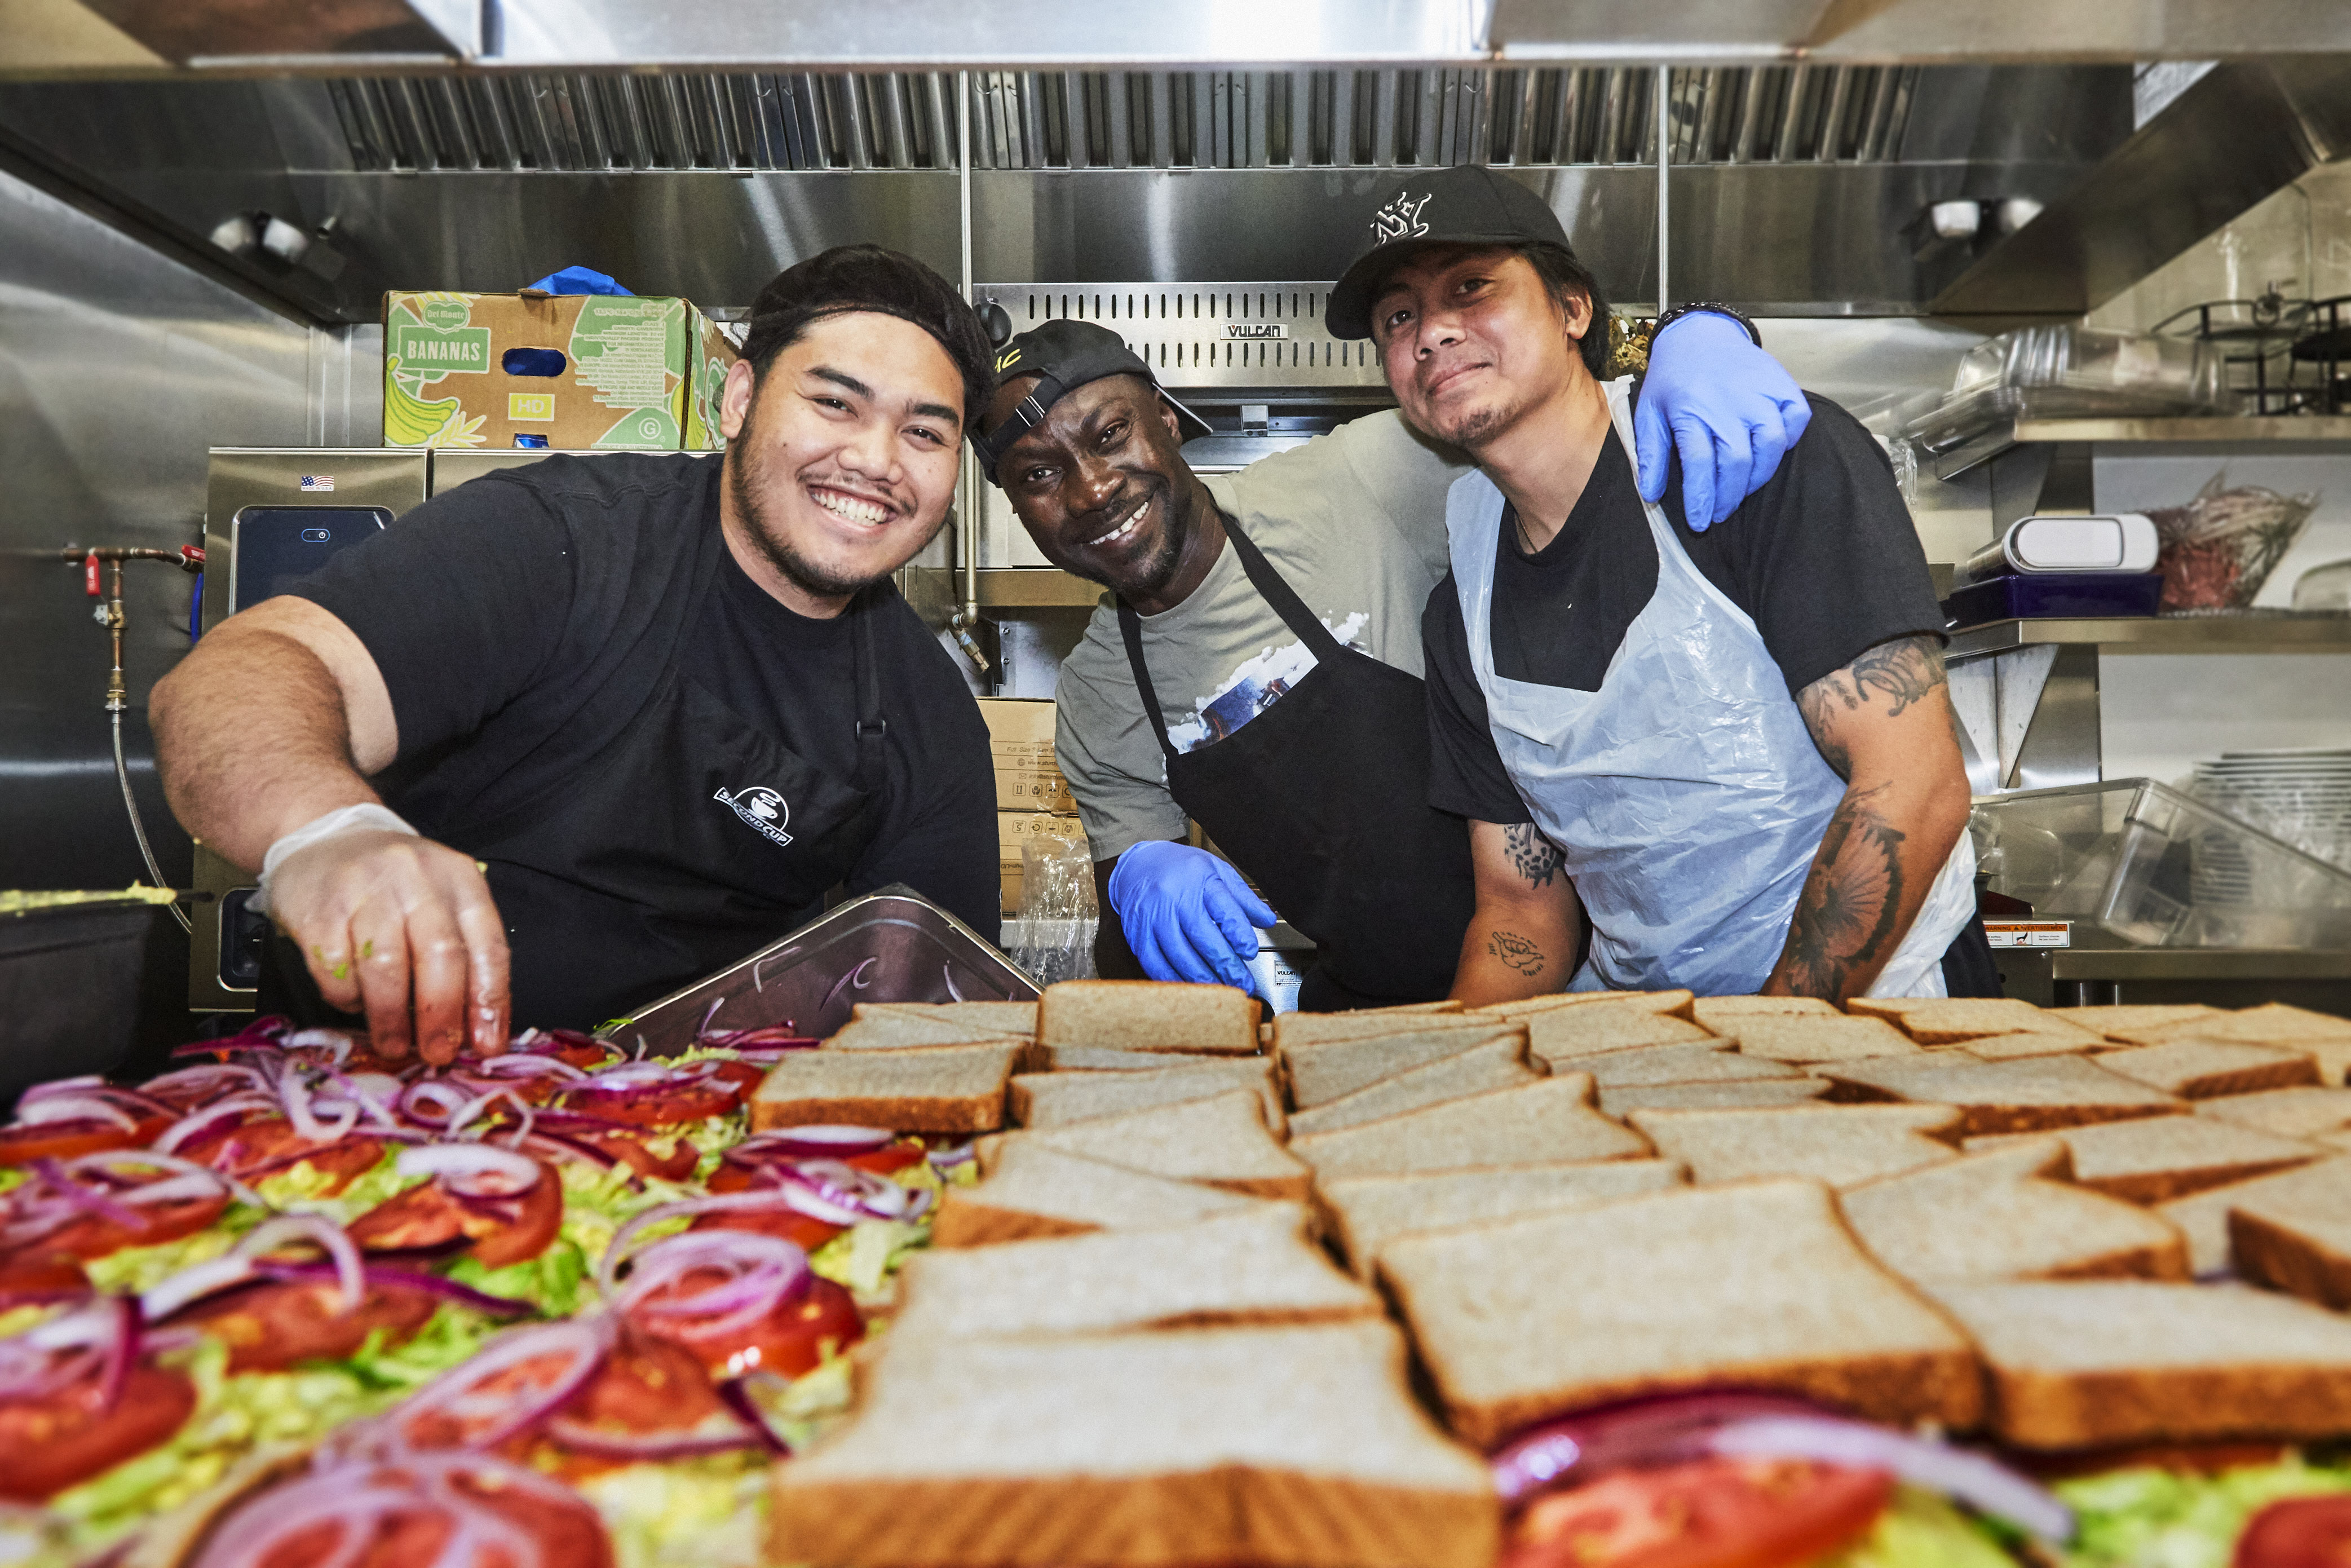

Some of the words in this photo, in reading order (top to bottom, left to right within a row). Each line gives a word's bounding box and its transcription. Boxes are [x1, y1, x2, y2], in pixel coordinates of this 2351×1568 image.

[1371, 192, 1431, 246] NY
[427, 310, 439, 318] Del
[440, 311, 465, 319] Monte
[1228, 325, 1280, 337] VULCAN
[408, 340, 480, 361] BANANAS
[518, 399, 545, 413] HD
[762, 826, 787, 842] CUP
